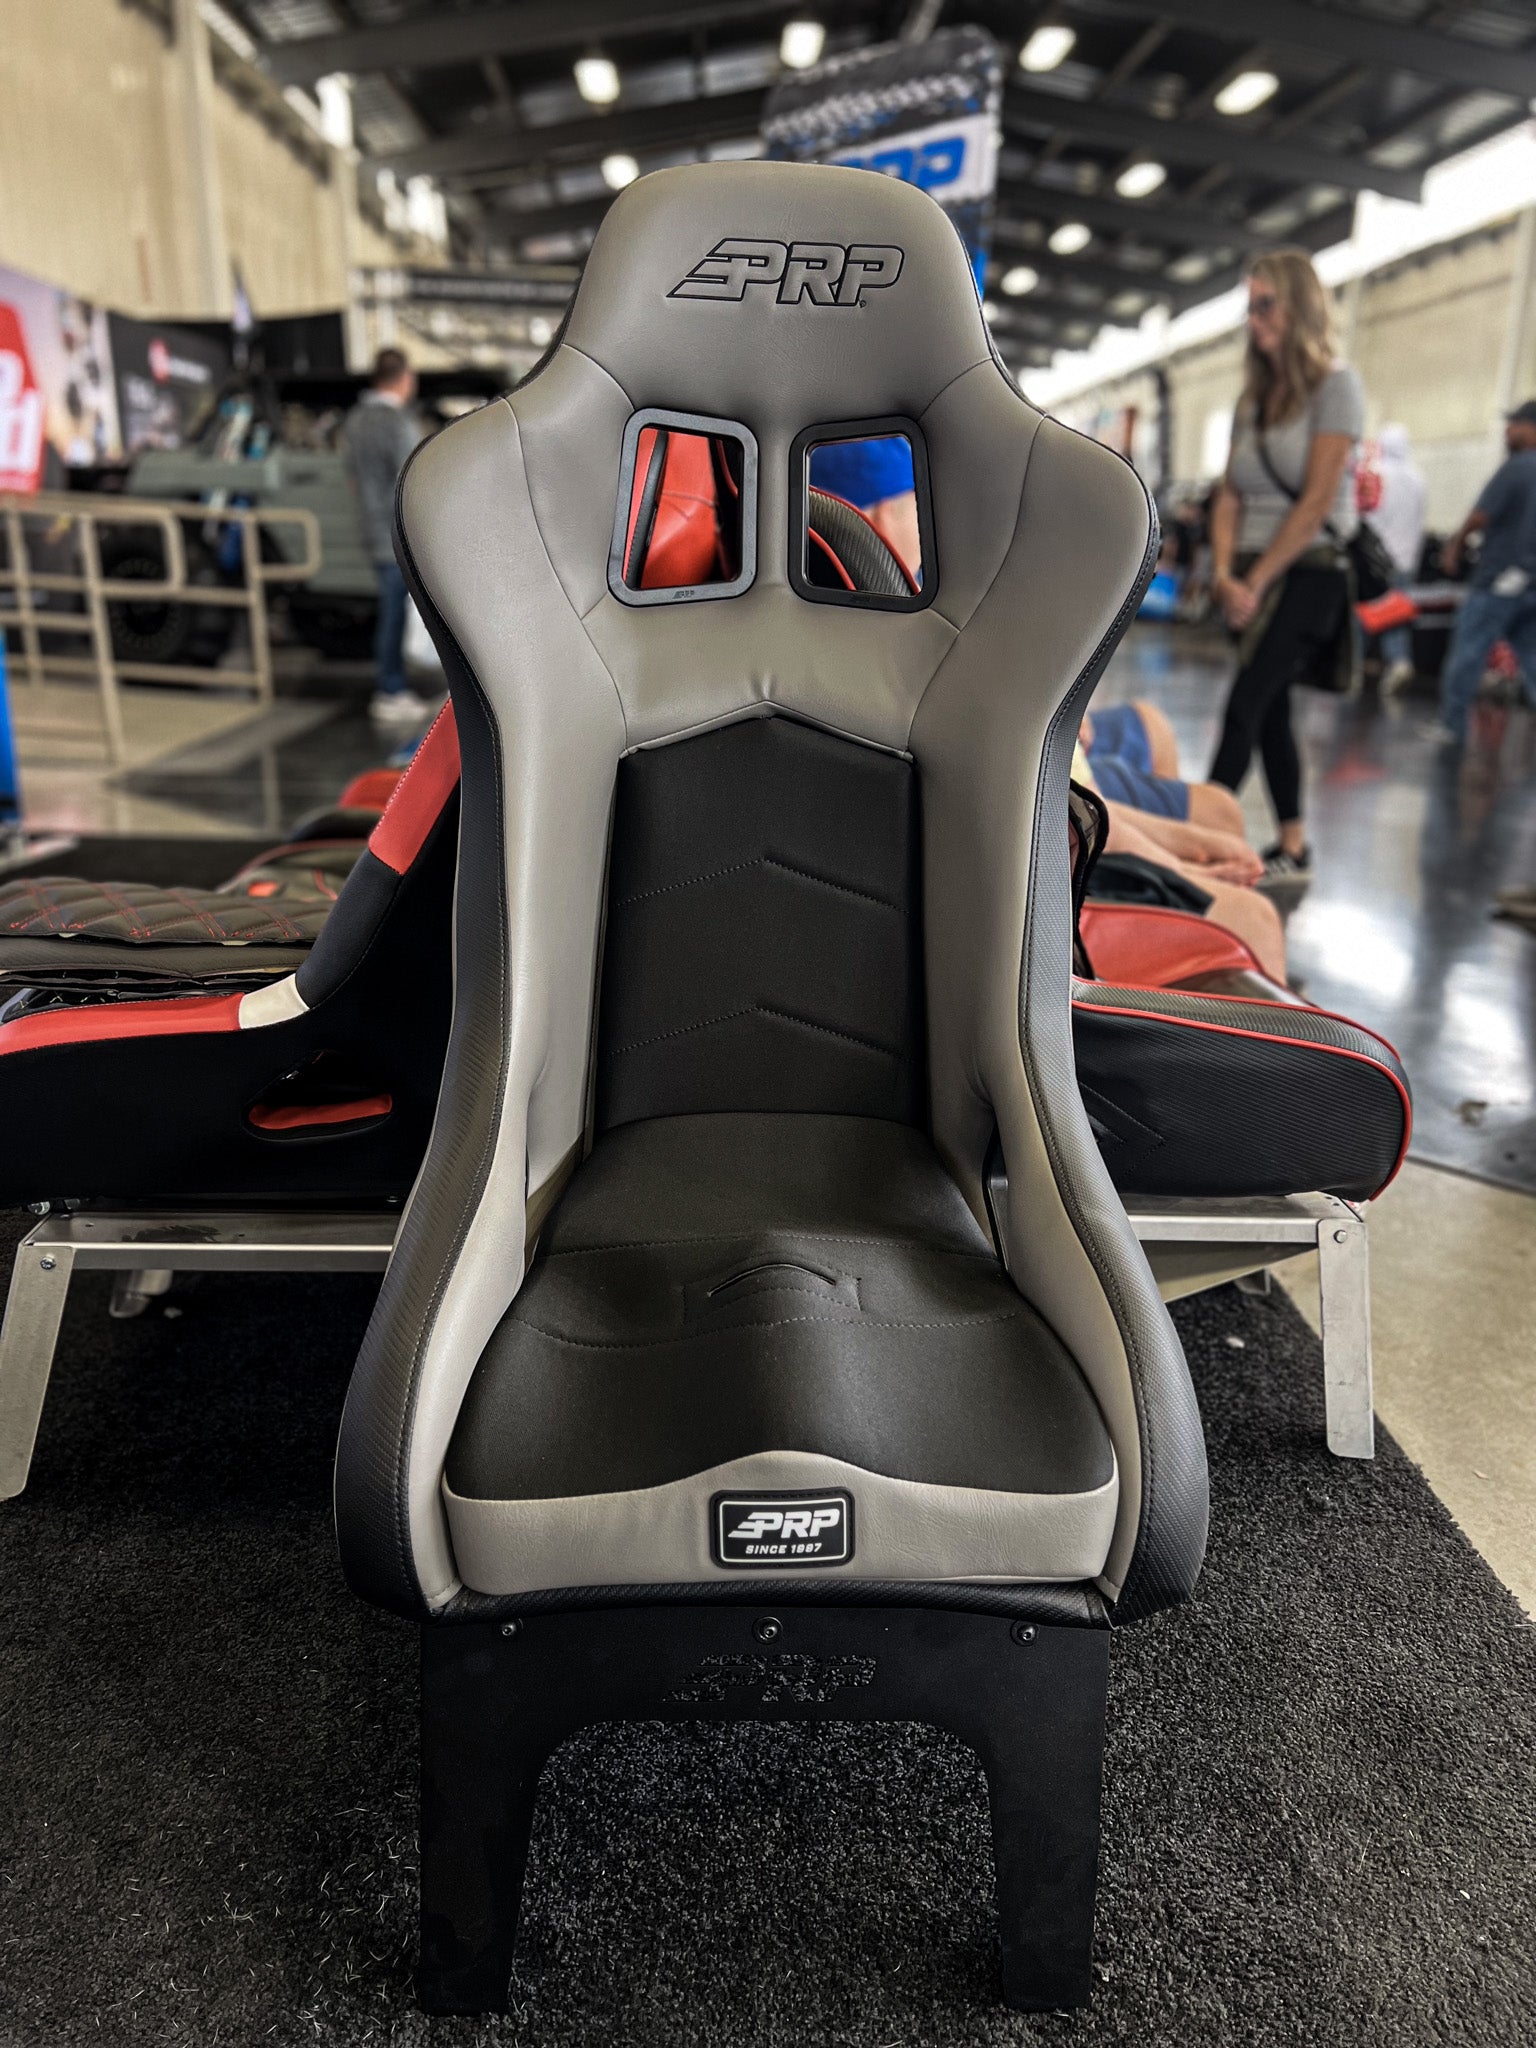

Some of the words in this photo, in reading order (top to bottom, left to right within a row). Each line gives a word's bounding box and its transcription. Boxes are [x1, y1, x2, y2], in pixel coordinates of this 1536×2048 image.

[665, 238, 905, 305] PRP
[728, 1508, 840, 1538] PRP
[745, 1544, 787, 1554] SINCE
